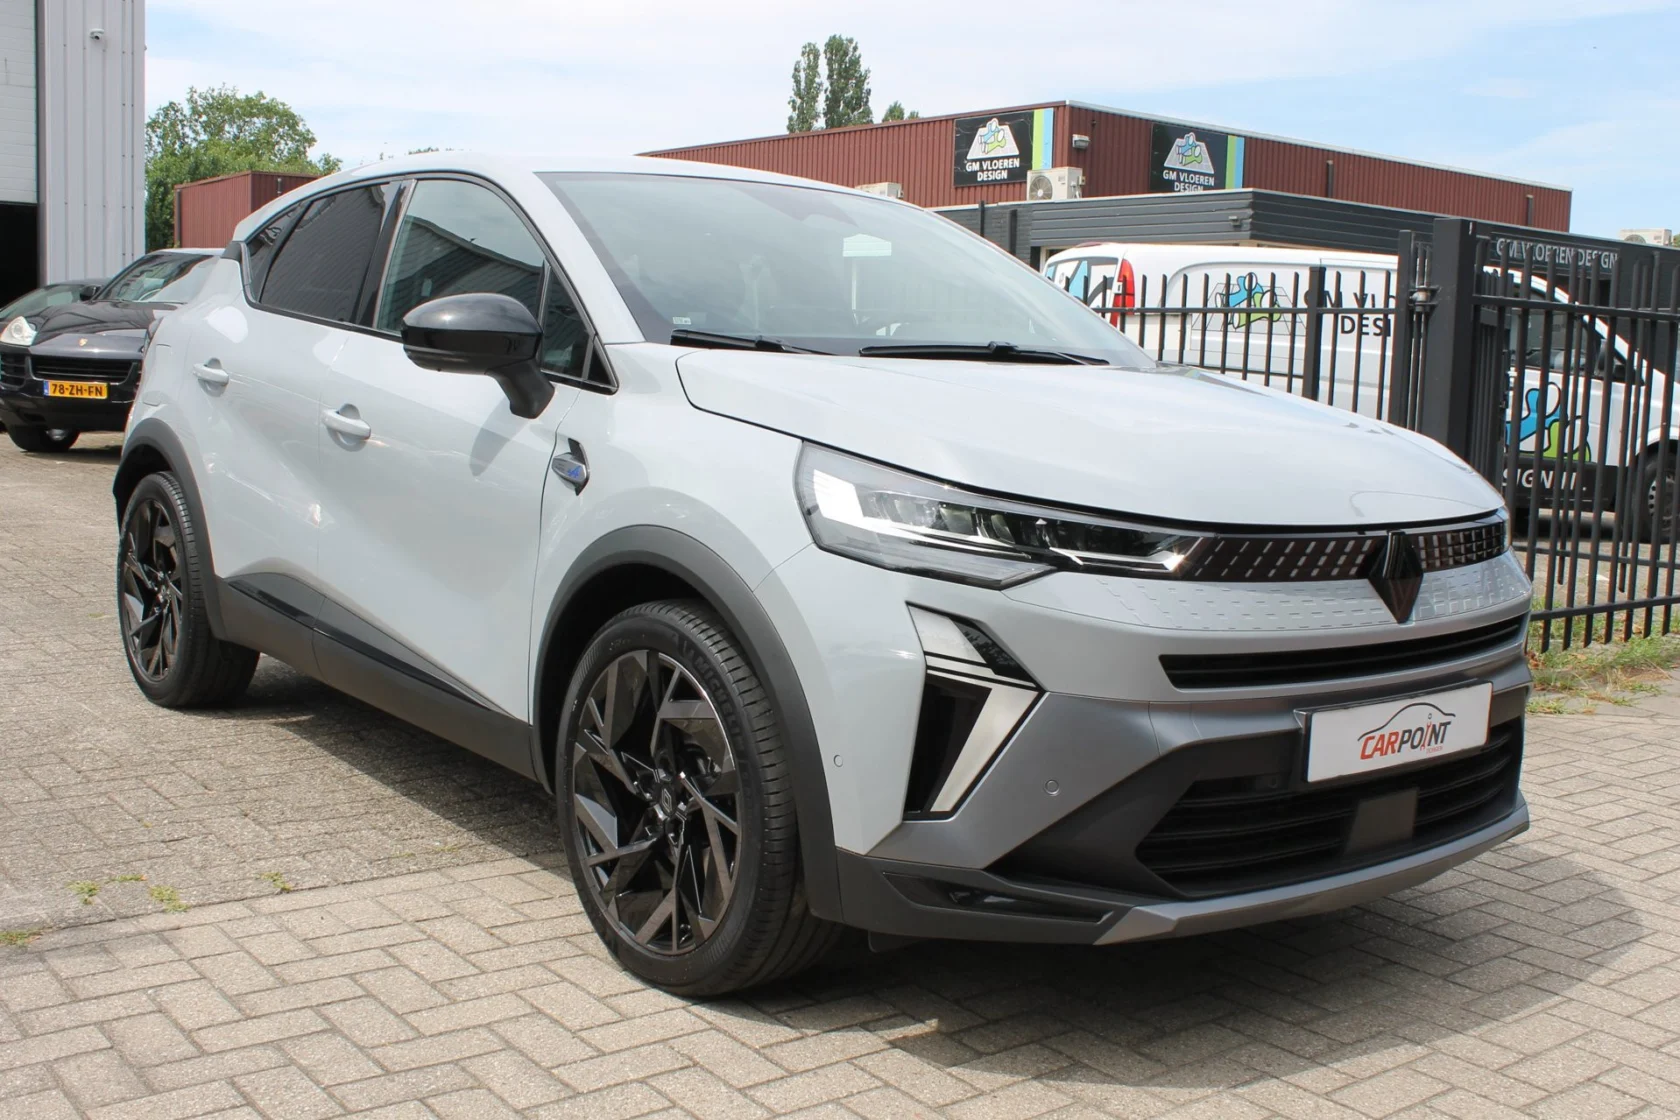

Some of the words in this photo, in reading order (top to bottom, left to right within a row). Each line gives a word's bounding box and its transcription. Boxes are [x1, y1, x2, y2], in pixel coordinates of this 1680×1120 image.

[965, 161, 980, 172] GM
[982, 158, 1020, 171] VLOEREN
[977, 170, 1008, 181] DESIGN
[1162, 169, 1177, 181] GM
[1179, 171, 1215, 187] VLOEREN
[1174, 182, 1204, 193] DESIGN
[51, 383, 104, 397] 78-ZH-FN
[1360, 719, 1452, 760] CARPOINT
